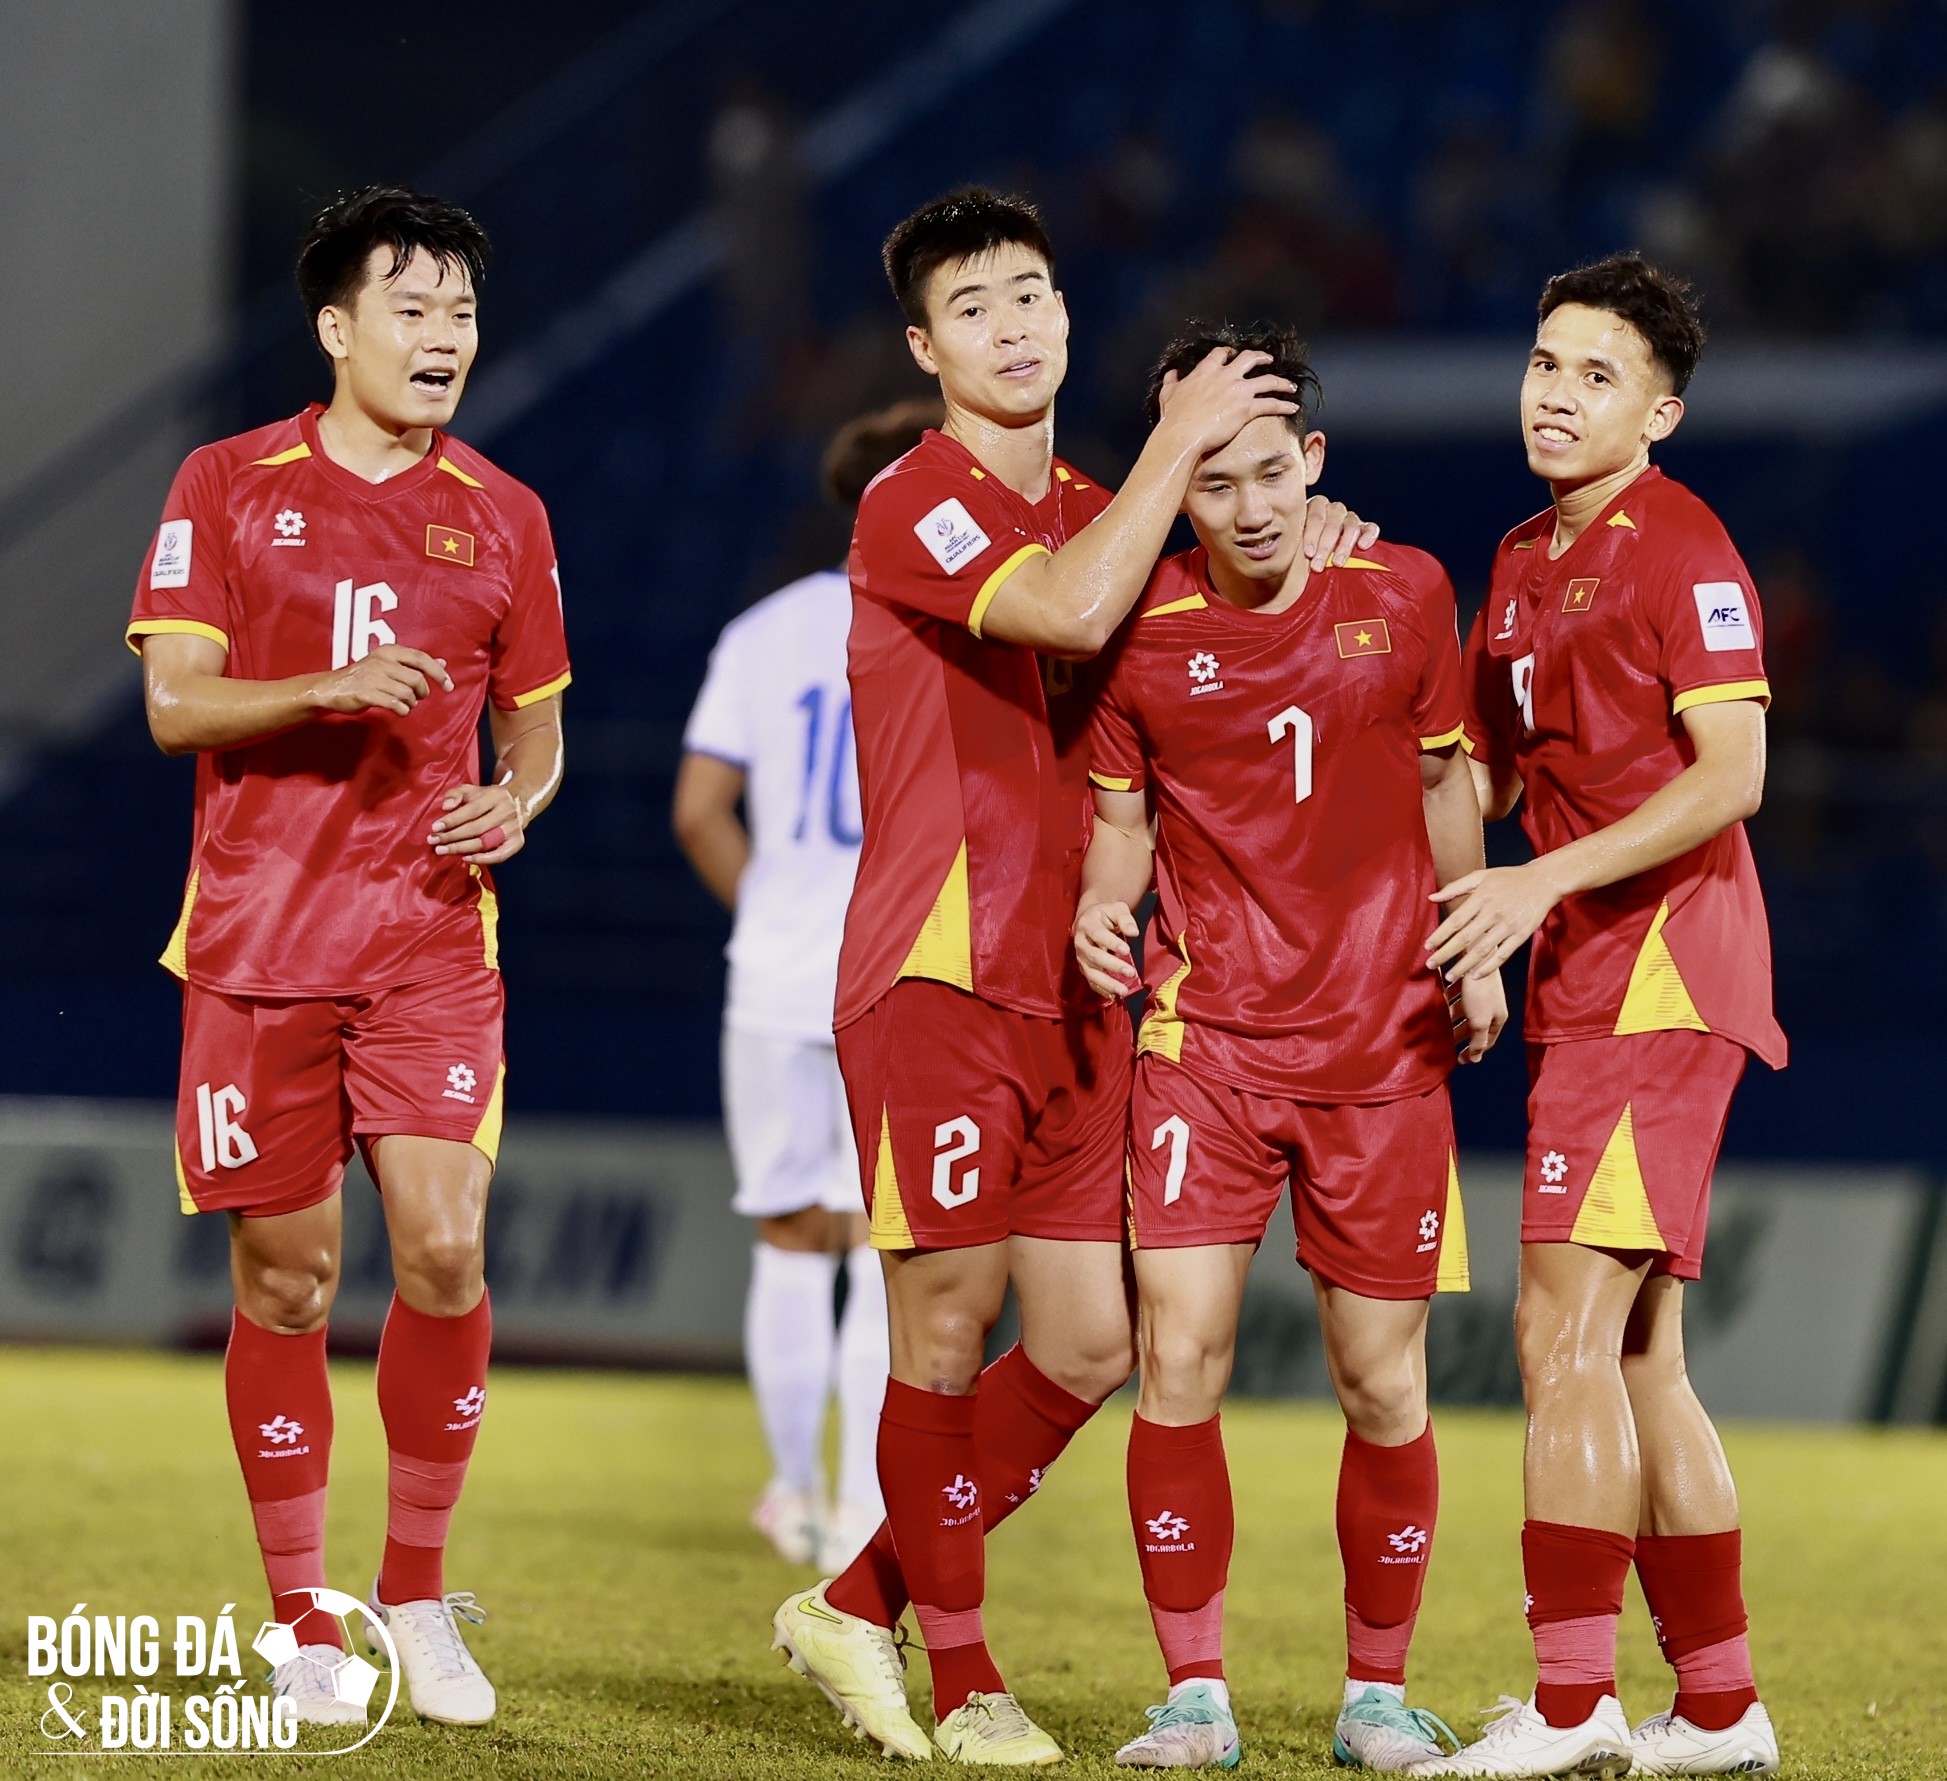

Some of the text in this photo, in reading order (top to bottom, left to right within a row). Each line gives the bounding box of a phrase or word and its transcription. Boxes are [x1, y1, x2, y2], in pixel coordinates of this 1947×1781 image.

[946, 535, 980, 563] QUALIFIERS
[332, 578, 398, 671] 16
[1708, 607, 1740, 623] AFC
[1267, 705, 1312, 804] 7
[197, 1082, 259, 1173] 16
[931, 1114, 980, 1210] 2
[1151, 1114, 1190, 1207] 7
[1145, 1542, 1195, 1552] JOGARBOLA
